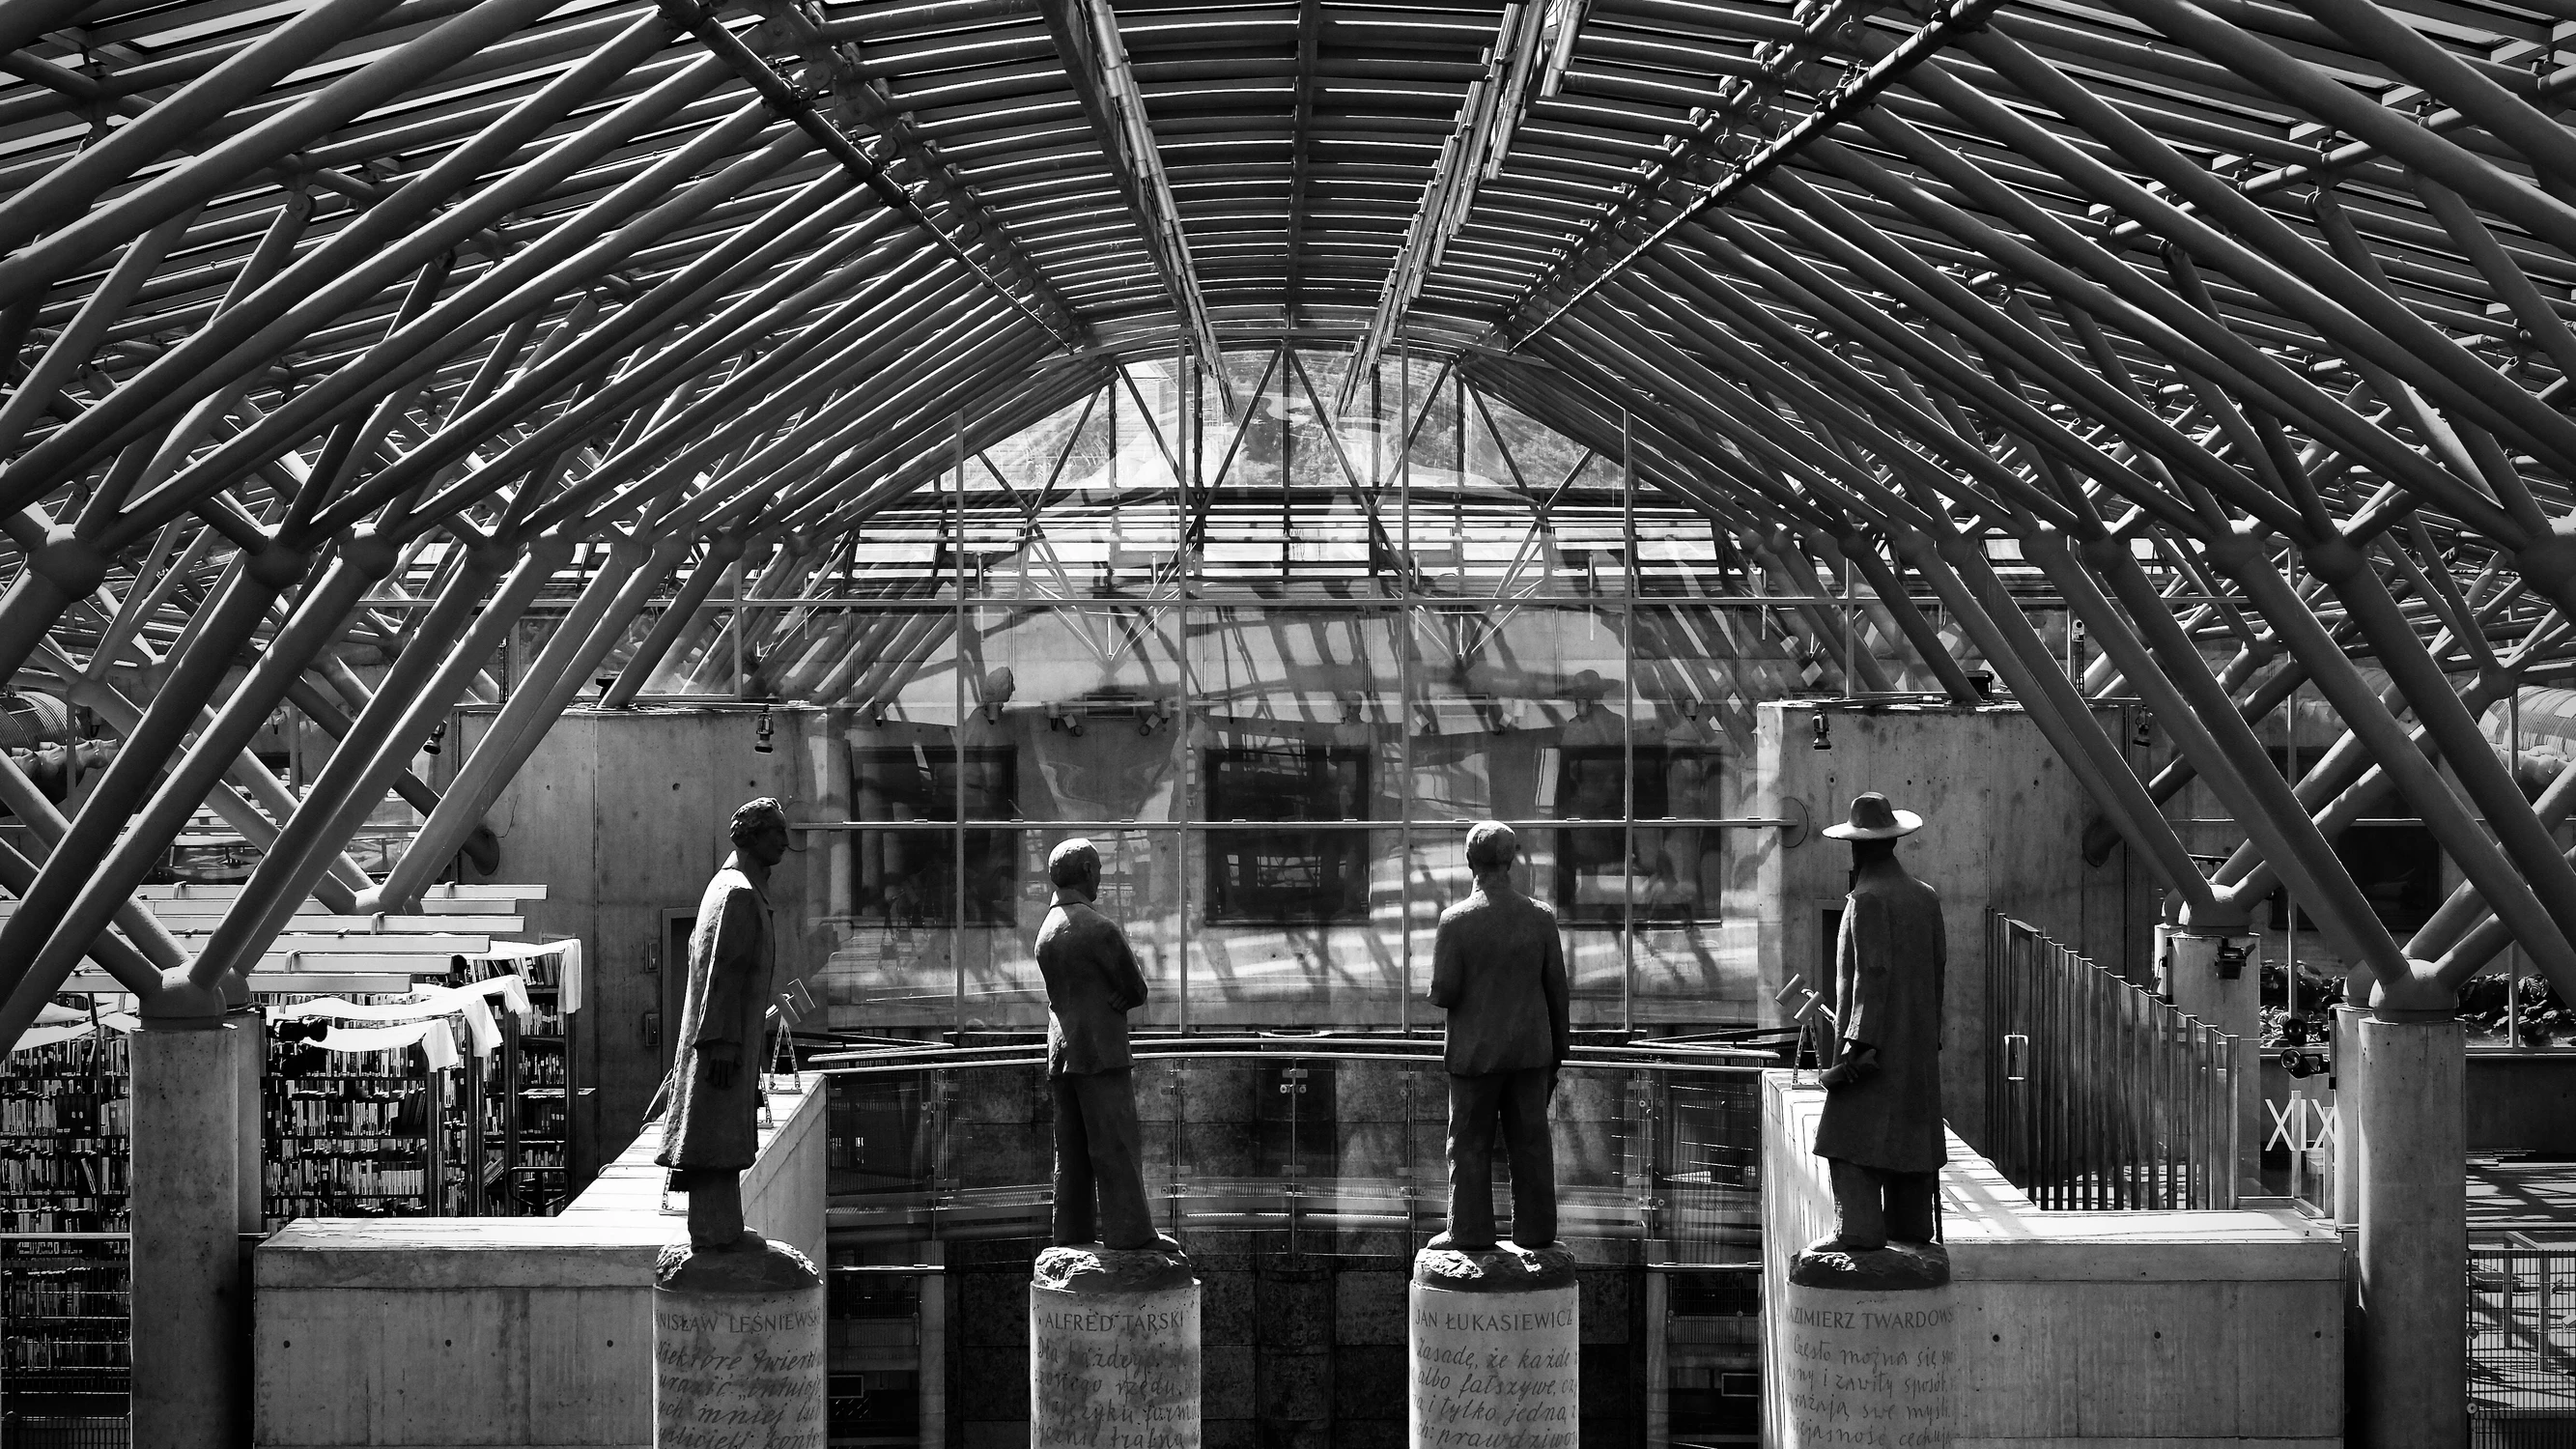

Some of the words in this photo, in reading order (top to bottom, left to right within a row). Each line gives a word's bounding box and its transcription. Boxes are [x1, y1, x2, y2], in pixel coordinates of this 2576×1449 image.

[2265, 1099, 2335, 1151] XIX
[1045, 1312, 1114, 1332] ALFRED
[1123, 1311, 1183, 1333] TARSKI
[1415, 1309, 1437, 1327] JAN
[1446, 1308, 1572, 1332] ŁUKASIEWICZ
[1486, 1348, 1509, 1370] że
[1517, 1348, 1570, 1370] każde
[1840, 1347, 1908, 1375] można
[1917, 1347, 1937, 1370] się
[1418, 1367, 1451, 1389] albo
[1458, 1373, 1555, 1402] fałszywe,
[1440, 1396, 1496, 1424] tylko
[1503, 1402, 1567, 1427] jedną
